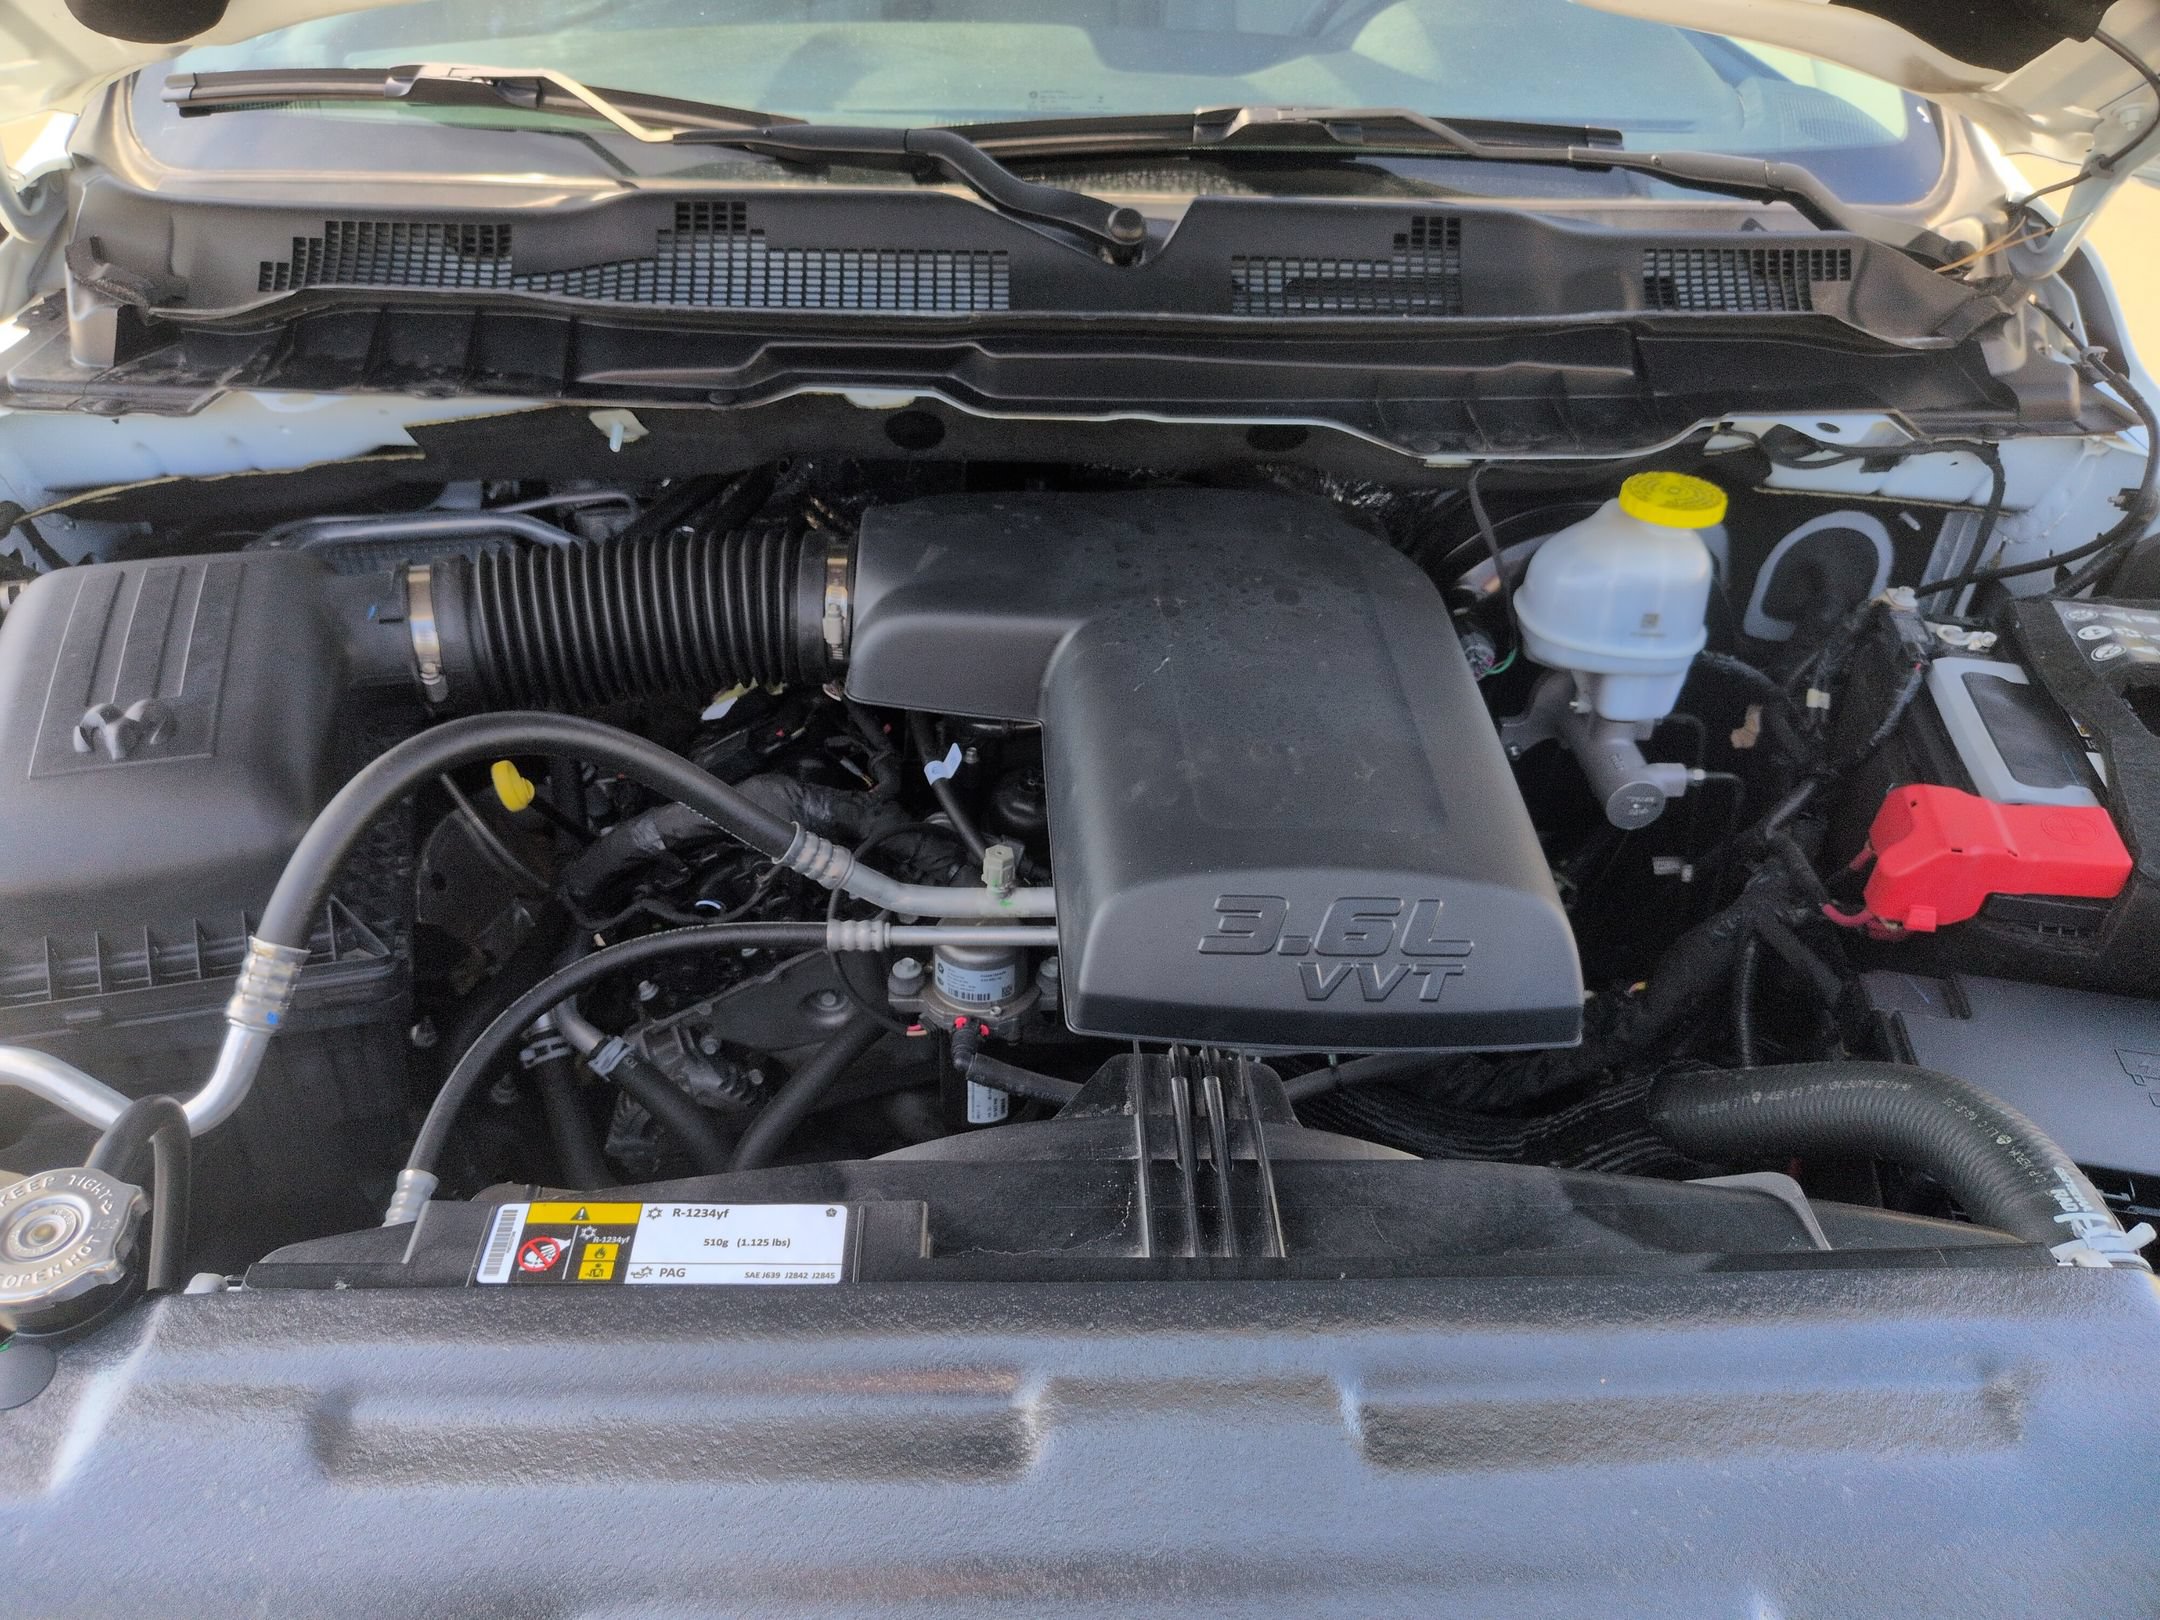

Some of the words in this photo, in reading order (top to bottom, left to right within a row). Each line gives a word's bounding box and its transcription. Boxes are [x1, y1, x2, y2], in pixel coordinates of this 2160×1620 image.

[1198, 894, 1475, 957] 3.6L
[1298, 961, 1466, 1002] VVT
[0, 1175, 56, 1208] KEEP
[672, 1207, 730, 1220] R-1234yf
[592, 1235, 631, 1245] R-1234yf
[703, 1238, 729, 1248] 510g
[736, 1237, 769, 1248] (1.125
[771, 1237, 791, 1248] lbs)
[1, 1262, 64, 1290] OPEN
[65, 1233, 102, 1266] HOT
[658, 1267, 687, 1278] PAG
[744, 1271, 761, 1279] SAE
[761, 1271, 781, 1279] J639
[784, 1271, 809, 1279] J2842
[811, 1271, 836, 1279] J2845
